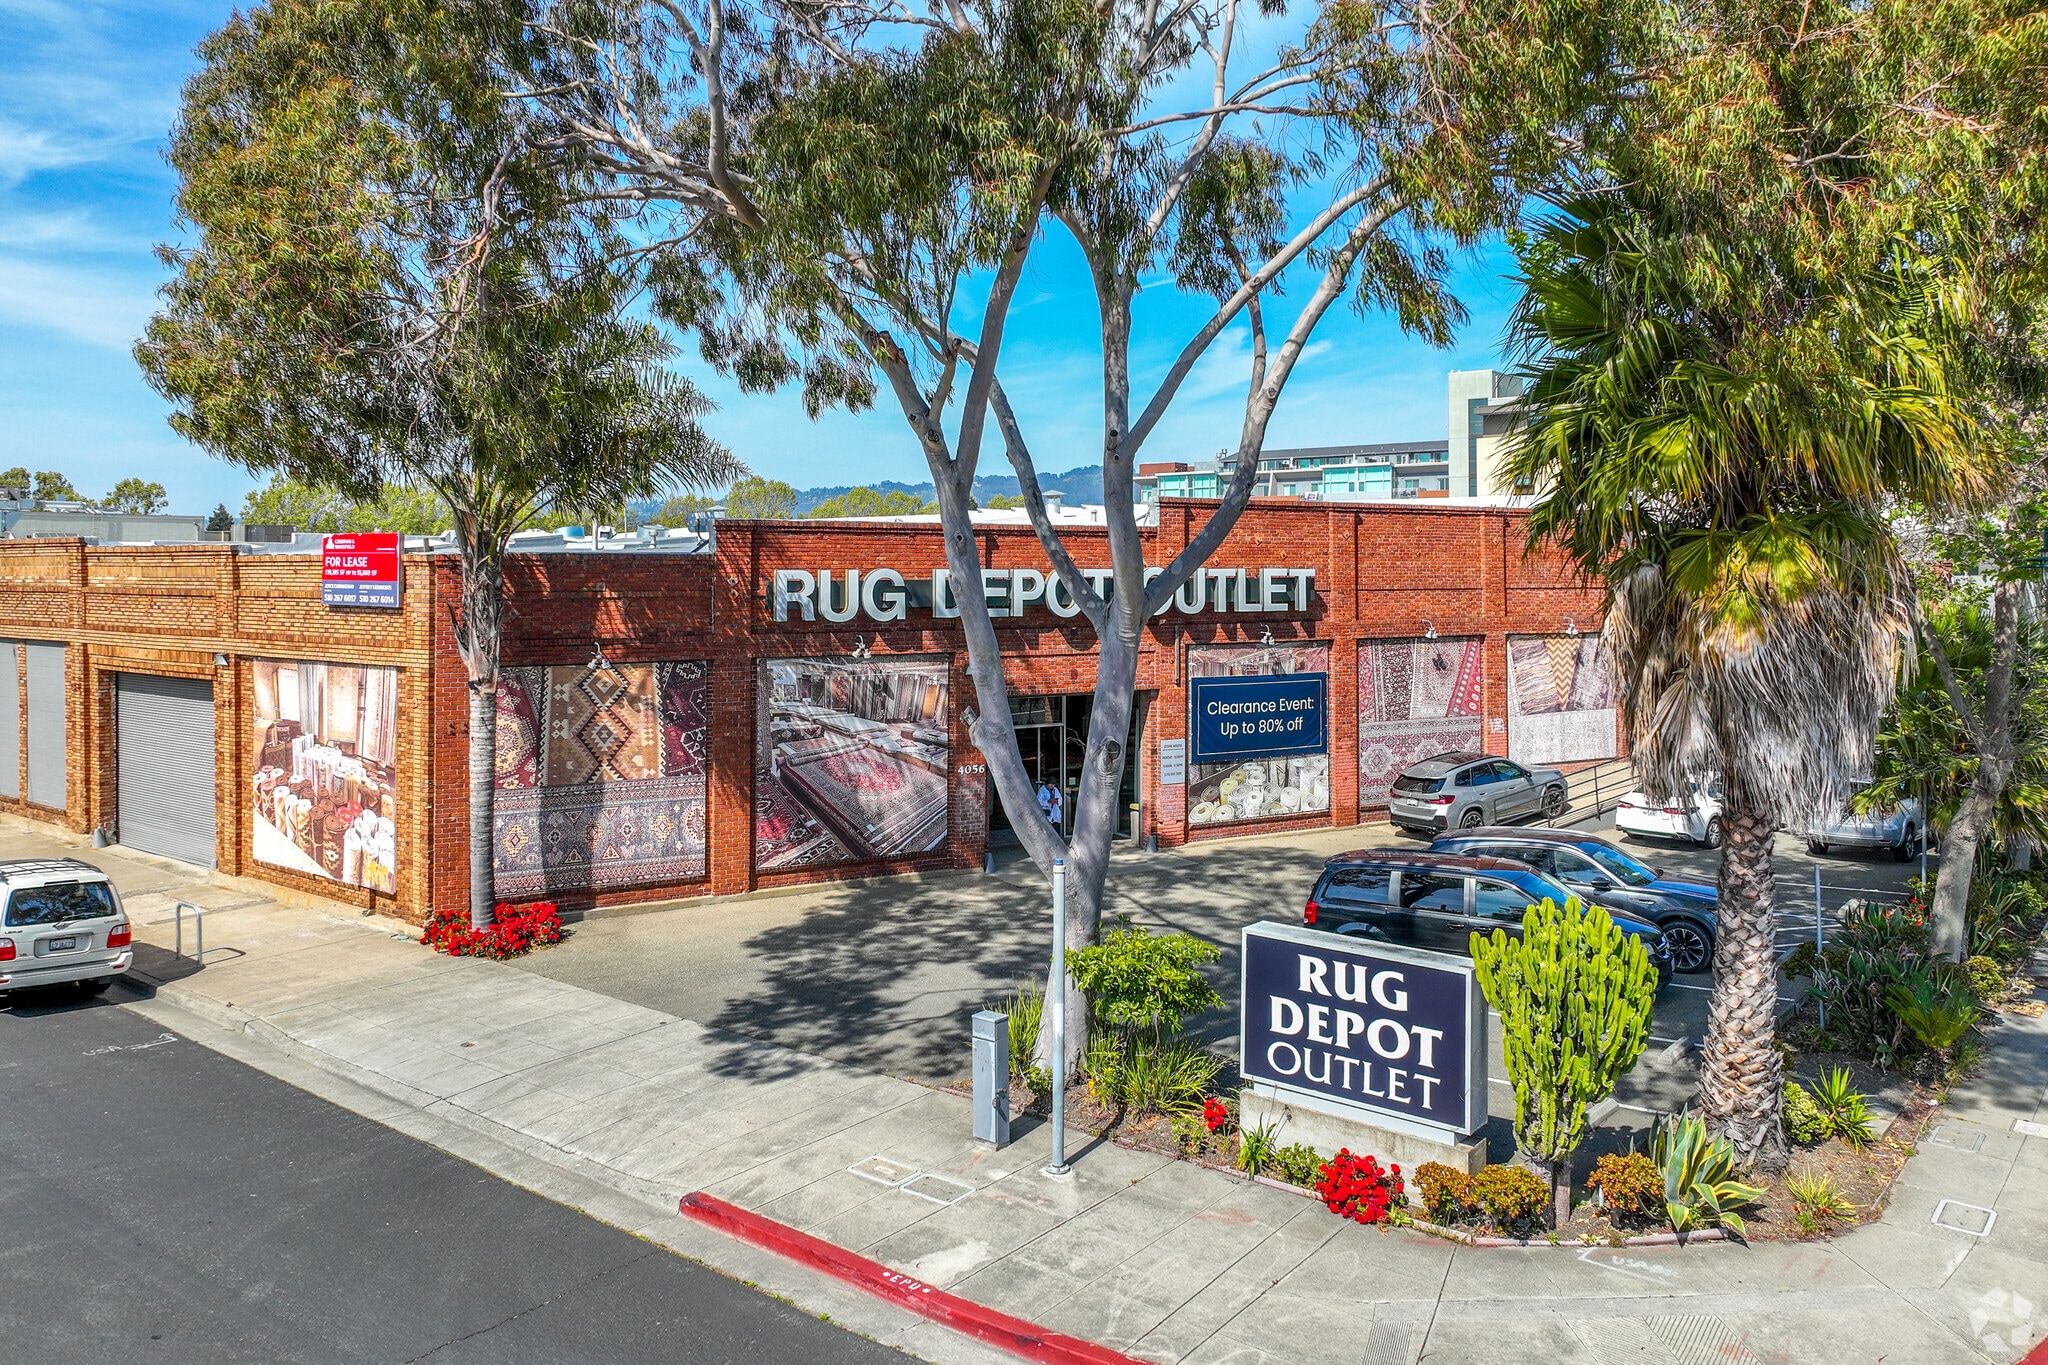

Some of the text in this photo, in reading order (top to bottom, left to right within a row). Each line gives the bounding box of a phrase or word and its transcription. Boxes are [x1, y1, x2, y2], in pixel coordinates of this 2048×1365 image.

[325, 557, 368, 567] FOR LEASE
[774, 568, 906, 623] RUG
[1207, 697, 1314, 715] Clearance Event:
[1220, 717, 1304, 739] Up to 80% off
[958, 764, 985, 774] 4056
[1298, 954, 1408, 1011] RUG
[1270, 995, 1443, 1069] DEPOT
[1267, 1041, 1440, 1110] OUTLET
